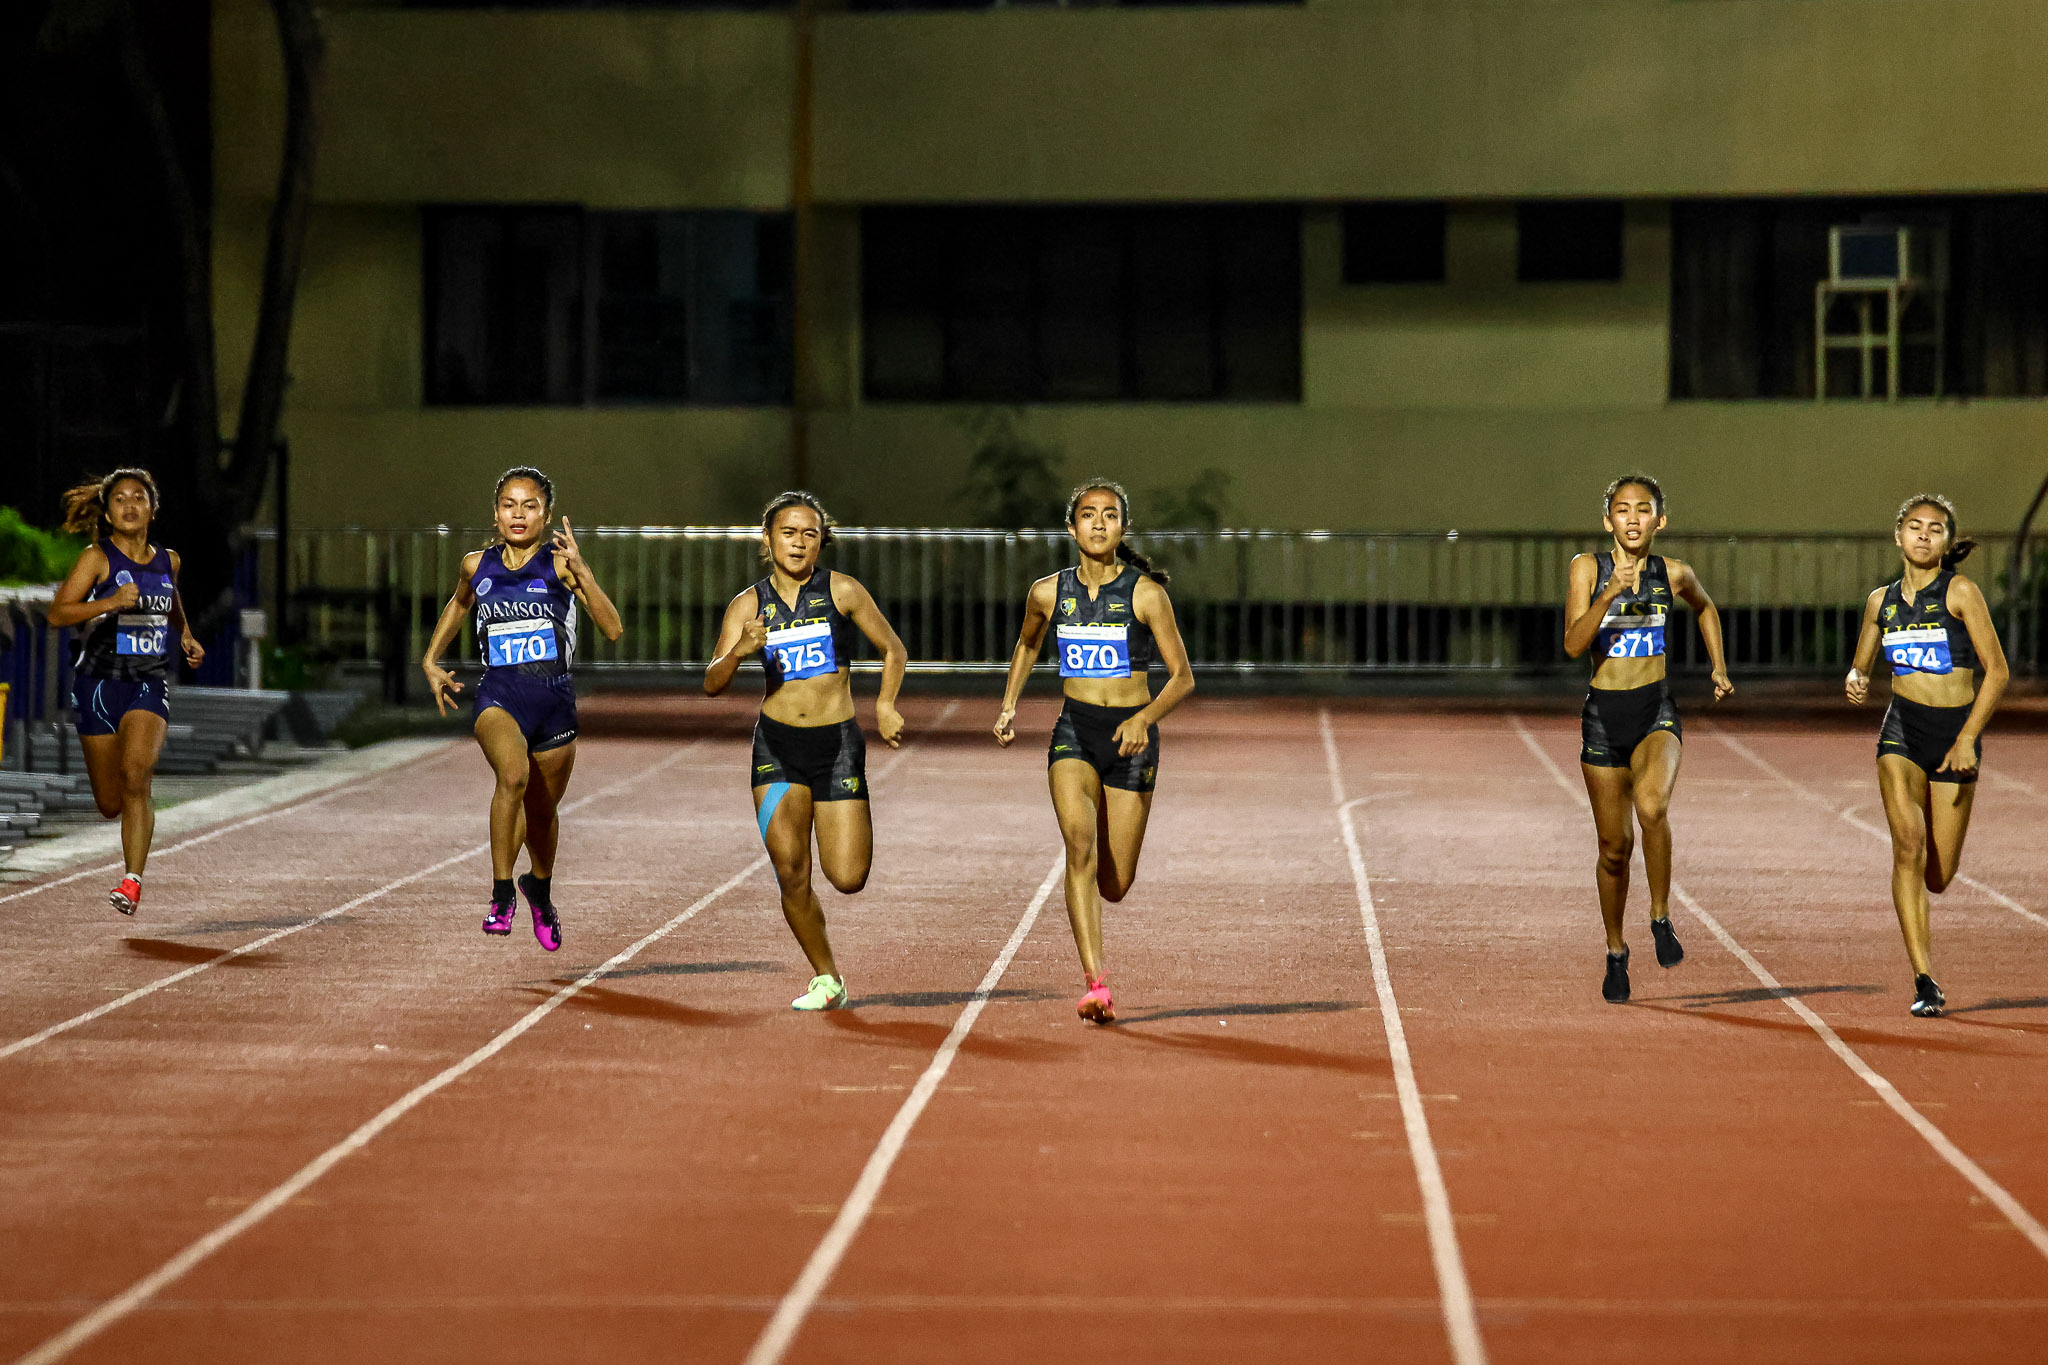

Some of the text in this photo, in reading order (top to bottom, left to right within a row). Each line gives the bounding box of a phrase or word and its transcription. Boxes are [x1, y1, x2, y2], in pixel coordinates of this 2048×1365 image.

[127, 629, 164, 654] 160
[499, 635, 546, 664] 170
[1608, 632, 1654, 657] 871
[773, 642, 826, 673] 875
[1066, 644, 1119, 669] 870
